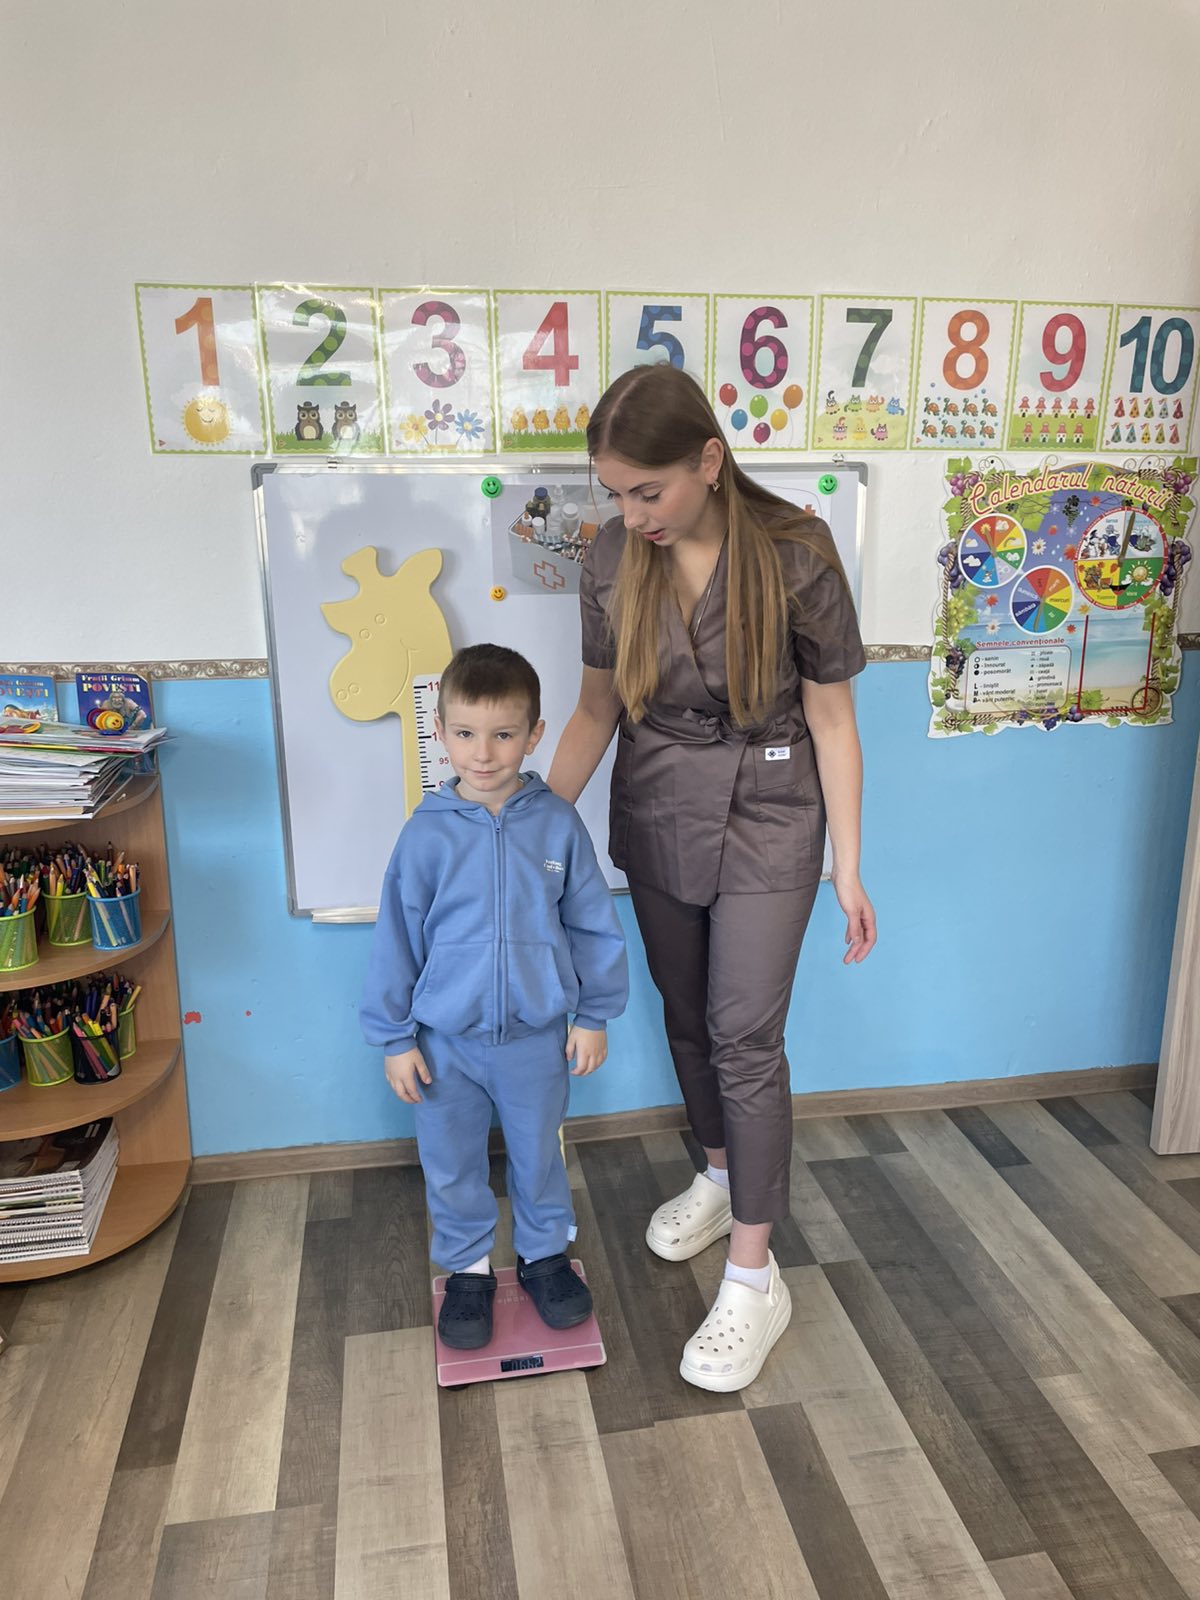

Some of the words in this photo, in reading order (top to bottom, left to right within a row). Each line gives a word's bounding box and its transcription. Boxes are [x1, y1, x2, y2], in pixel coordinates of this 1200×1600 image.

[174, 297, 220, 386] 1
[291, 299, 352, 386] 2
[411, 301, 466, 388] 3
[522, 302, 579, 386] 4
[635, 305, 686, 370] 5
[740, 306, 789, 389] 6
[846, 308, 893, 388] 7
[942, 310, 990, 390] 8
[1039, 313, 1087, 392] 9
[1120, 316, 1195, 395] 10
[970, 463, 1094, 515] Calendarul
[1101, 475, 1173, 510] naturii
[428, 681, 440, 691] 11
[439, 757, 449, 765] 95
